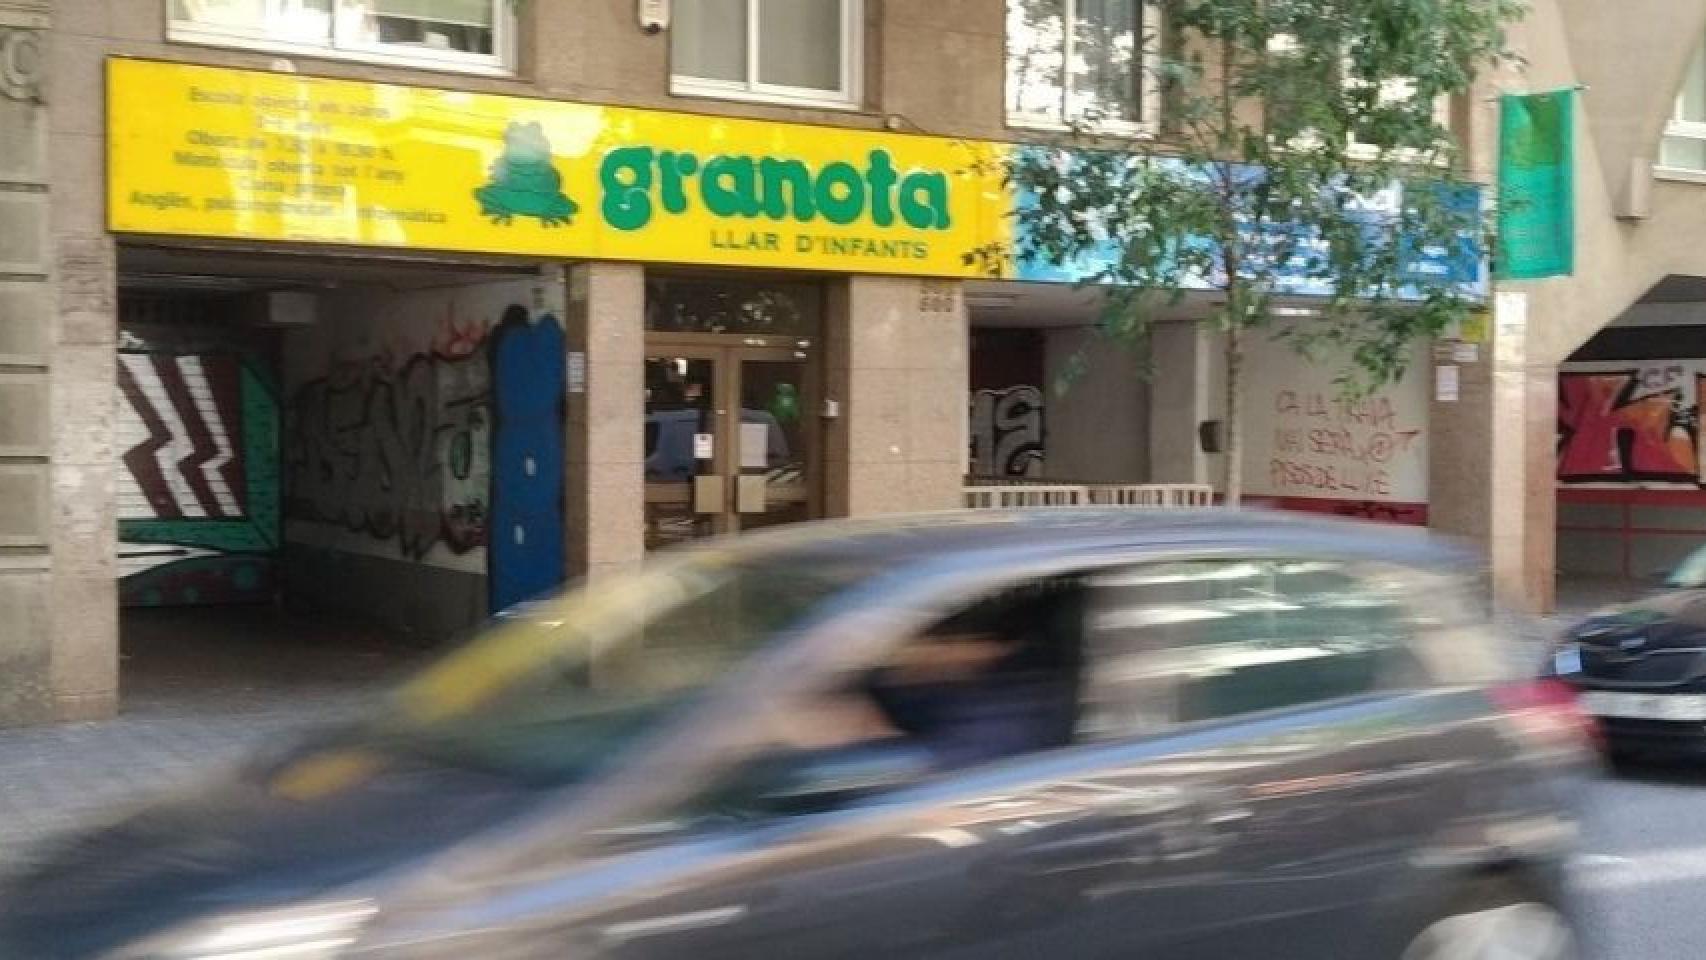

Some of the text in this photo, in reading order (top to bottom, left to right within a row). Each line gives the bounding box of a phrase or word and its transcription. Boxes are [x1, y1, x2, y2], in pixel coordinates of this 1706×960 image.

[600, 145, 952, 231] granota
[710, 231, 929, 259] LLAR D'INFANTS
